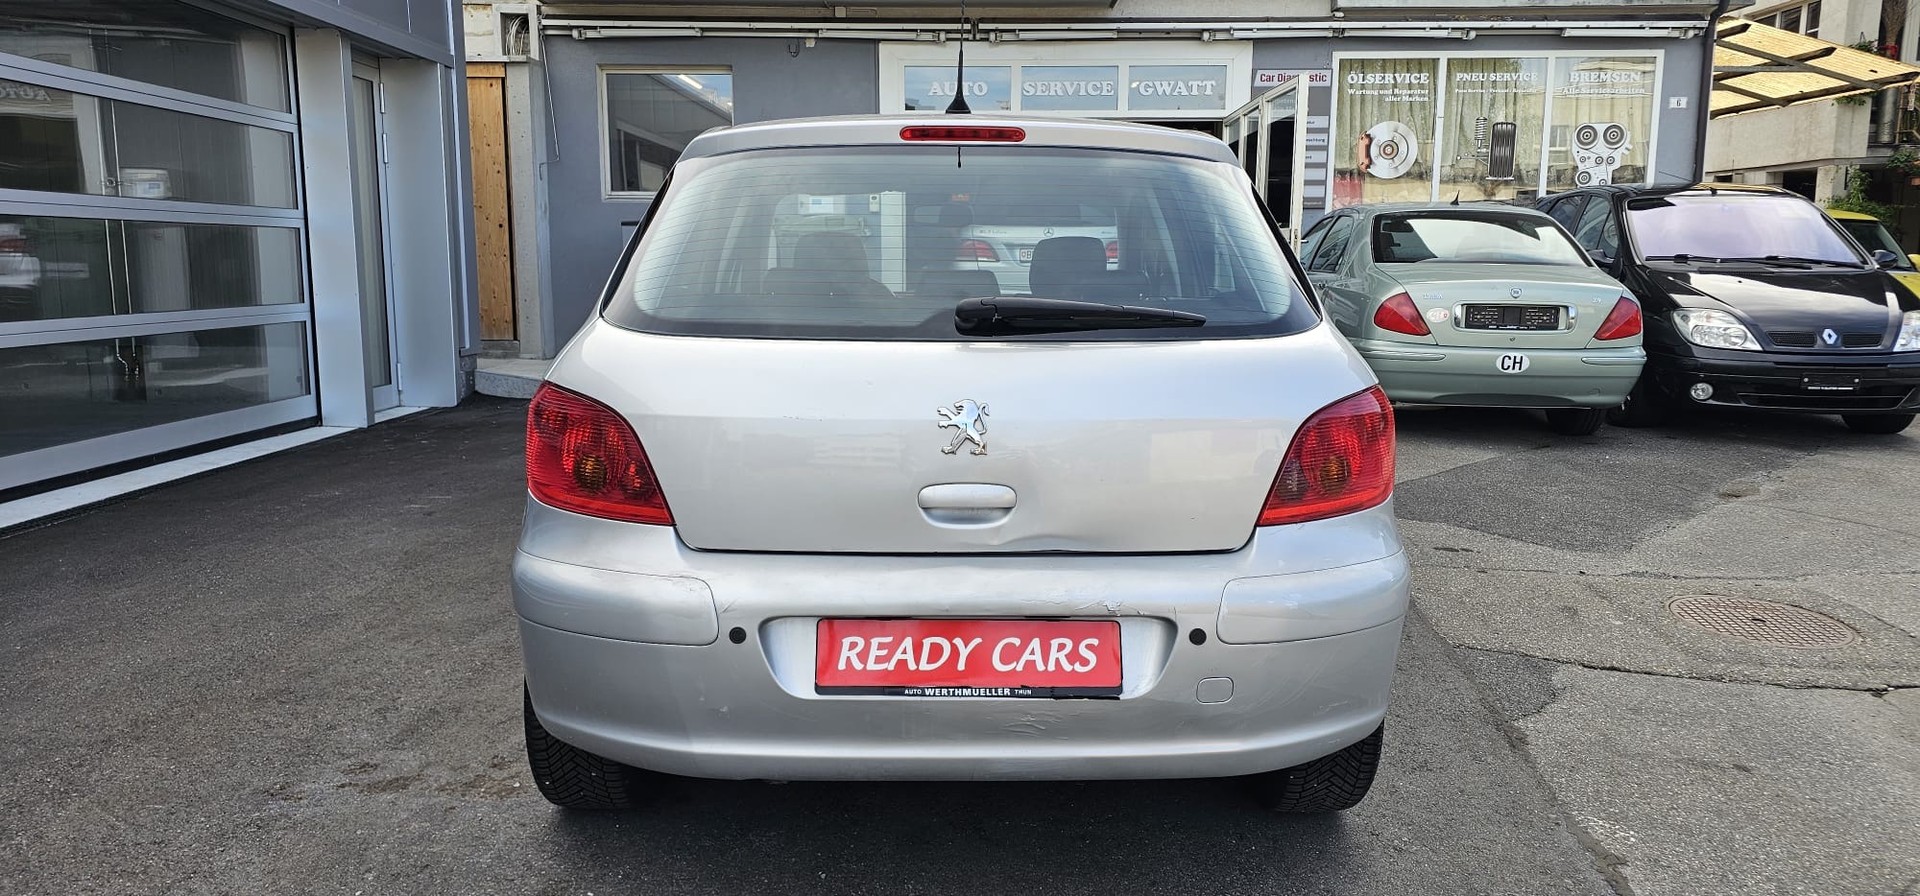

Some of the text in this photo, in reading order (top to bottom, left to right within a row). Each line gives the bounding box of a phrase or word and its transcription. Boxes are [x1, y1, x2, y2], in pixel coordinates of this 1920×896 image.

[1260, 72, 1328, 83] Car Diastic
[1347, 71, 1430, 84] ÖLSERVICE
[1456, 73, 1538, 81] PNEU SERVICE
[1570, 71, 1641, 82] BREMSEN
[928, 81, 1216, 96] AUTO SERVICE GWATT
[1676, 99, 1682, 107] 6
[1501, 355, 1523, 371] CH
[837, 636, 1099, 671] READY CARS
[924, 687, 1011, 696] WERTHMUELLER
